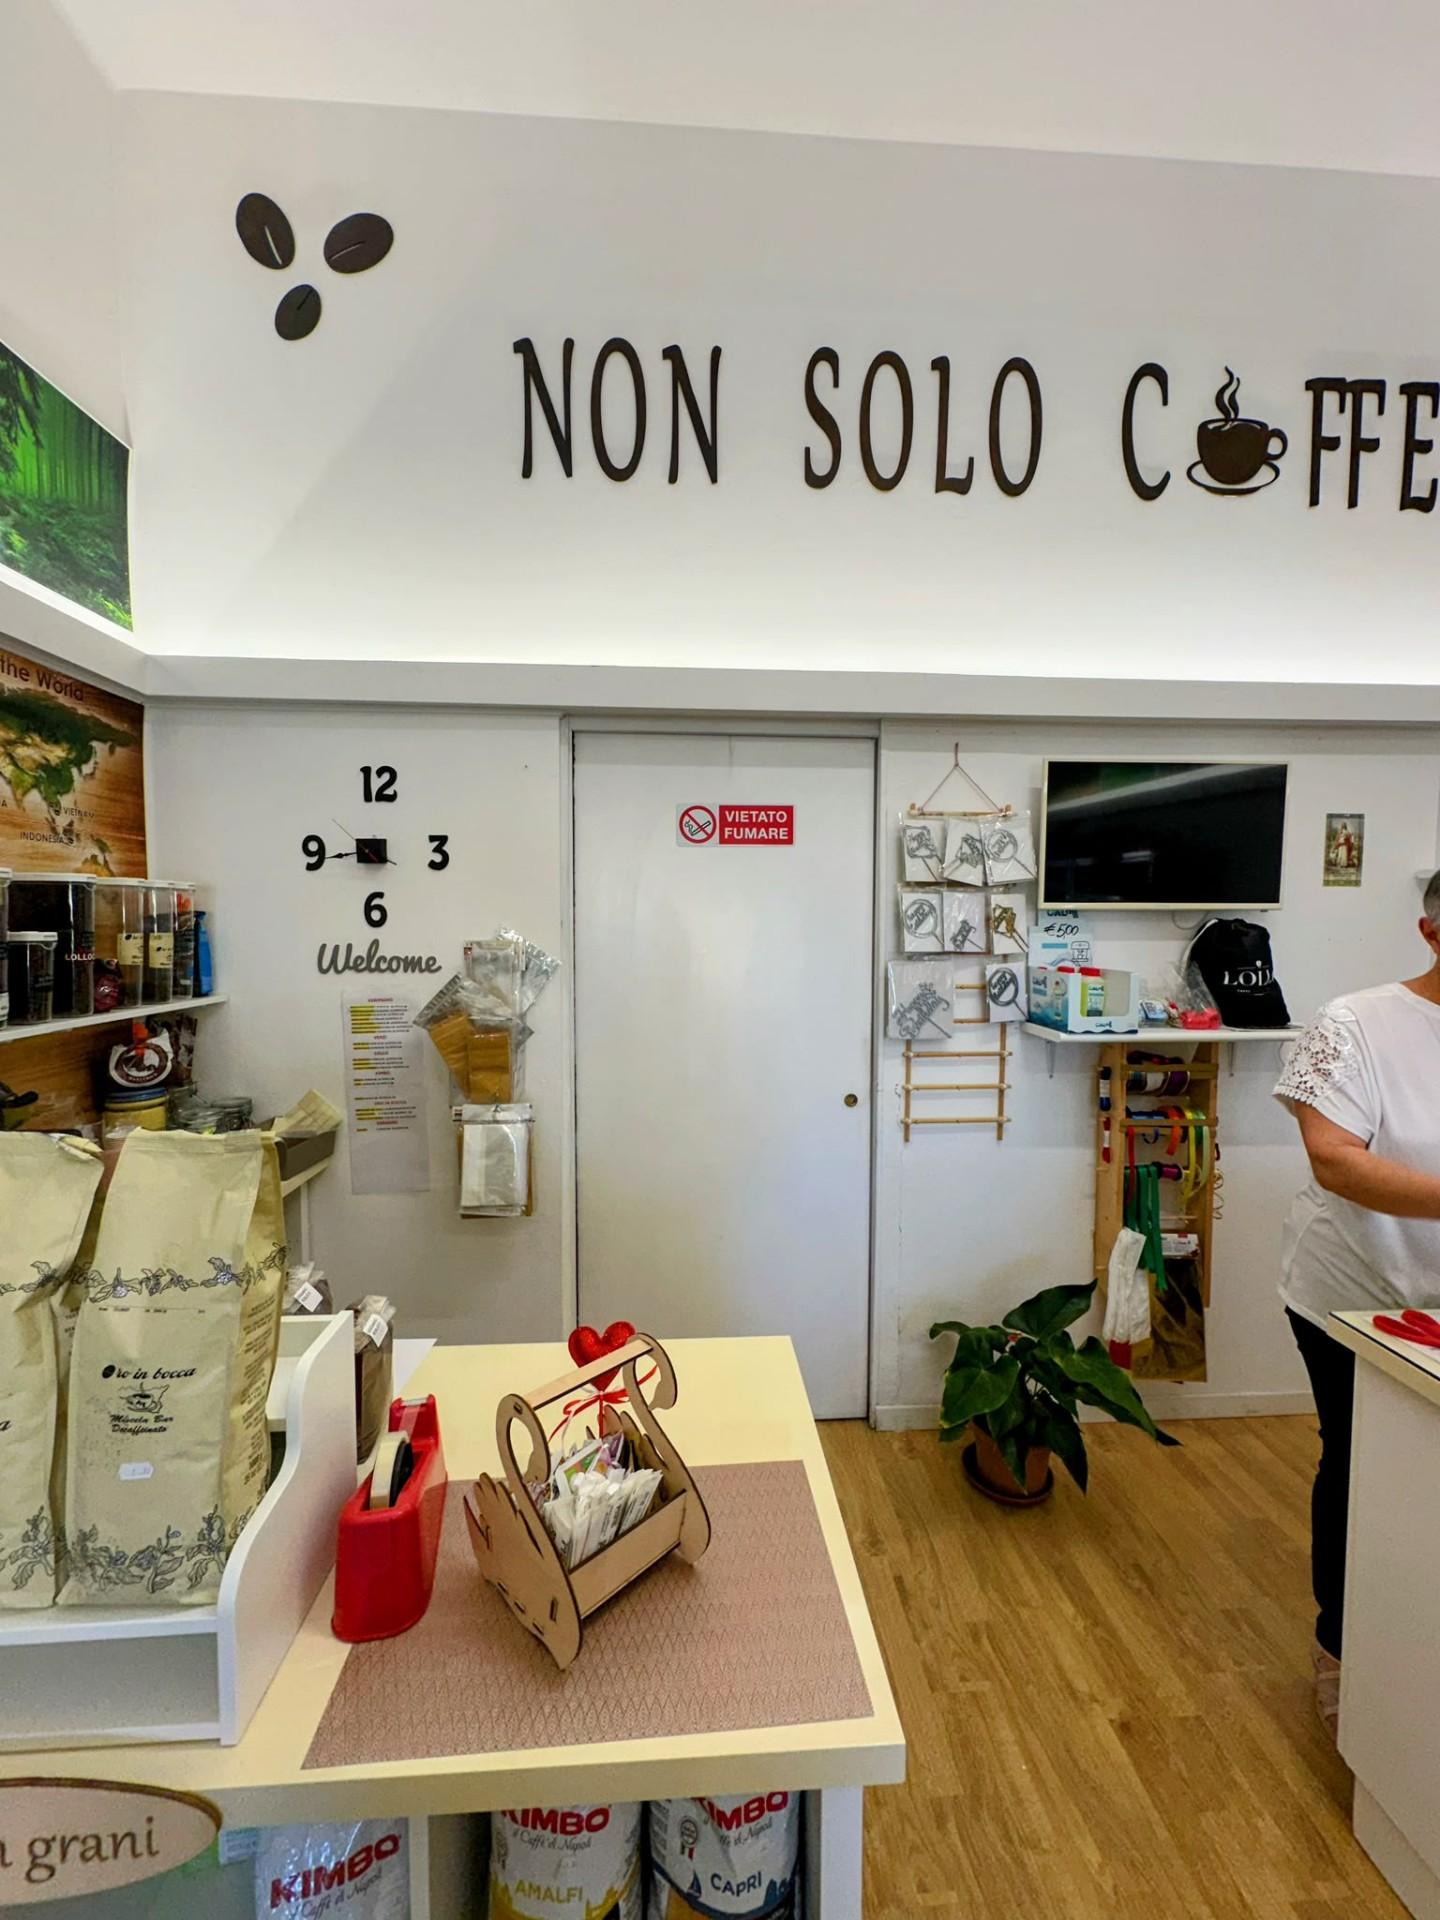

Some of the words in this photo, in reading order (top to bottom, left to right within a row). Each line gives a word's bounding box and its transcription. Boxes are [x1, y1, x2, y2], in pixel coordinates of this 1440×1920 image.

[513, 337, 723, 485] NON
[803, 346, 1043, 498] SOLO
[36, 669, 84, 701] World
[360, 765, 398, 802] 12
[724, 827, 789, 839] FUMARE
[725, 810, 788, 822] VIETATO
[20, 831, 64, 844] INDONESIA
[301, 834, 327, 871] 9
[427, 834, 450, 871] 3
[363, 891, 388, 928] 6
[317, 938, 442, 975] Welcome
[133, 1368, 148, 1379] in
[153, 1367, 197, 1379] bocca
[24, 1816, 160, 1884] grani
[270, 1832, 401, 1909] KIMBO
[710, 1870, 763, 1897] CAPRI
[515, 1879, 584, 1904] AMALFI
